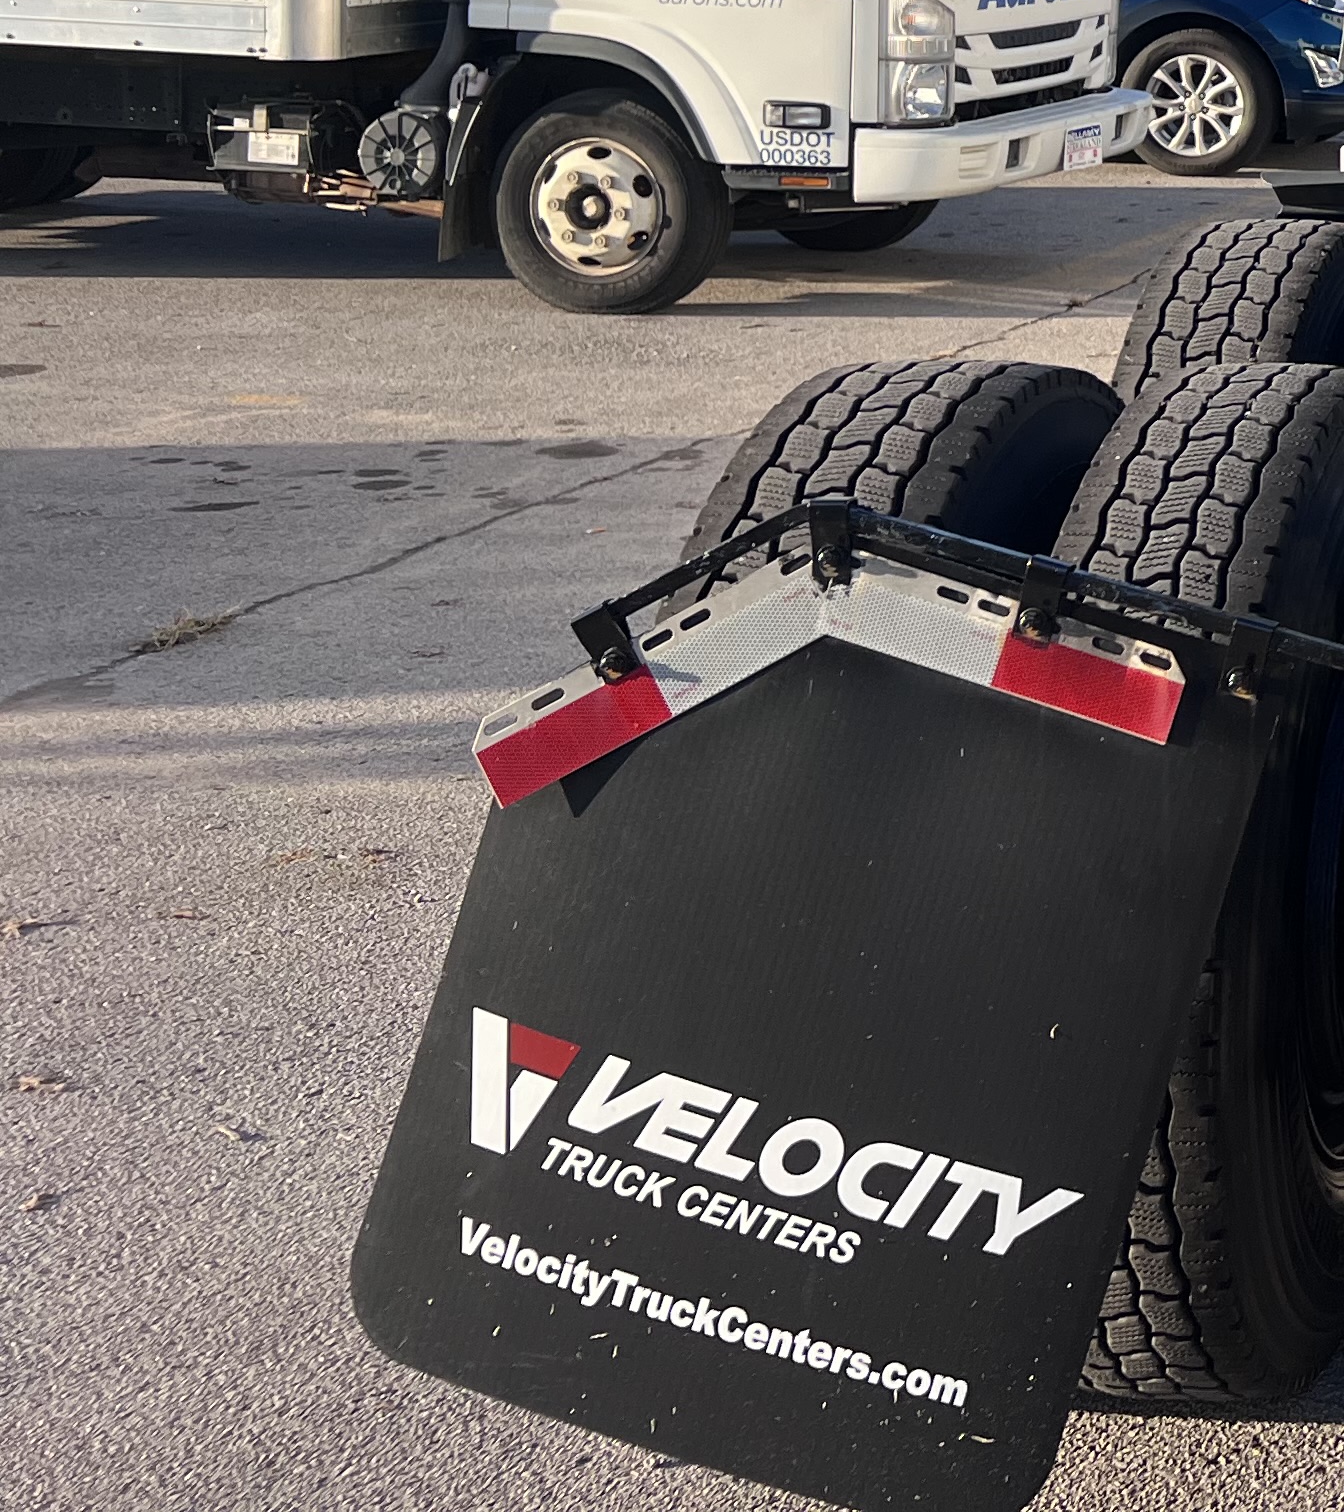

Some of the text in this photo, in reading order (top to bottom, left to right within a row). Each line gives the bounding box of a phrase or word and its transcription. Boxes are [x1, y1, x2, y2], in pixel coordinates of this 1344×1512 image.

[760, 129, 836, 149] USDOT
[760, 147, 832, 166] 000363
[540, 1137, 862, 1265] TRUCK CENTERS
[567, 1054, 1085, 1256] VELOCITY
[460, 1216, 969, 1408] VelocityTruckCenters.com
